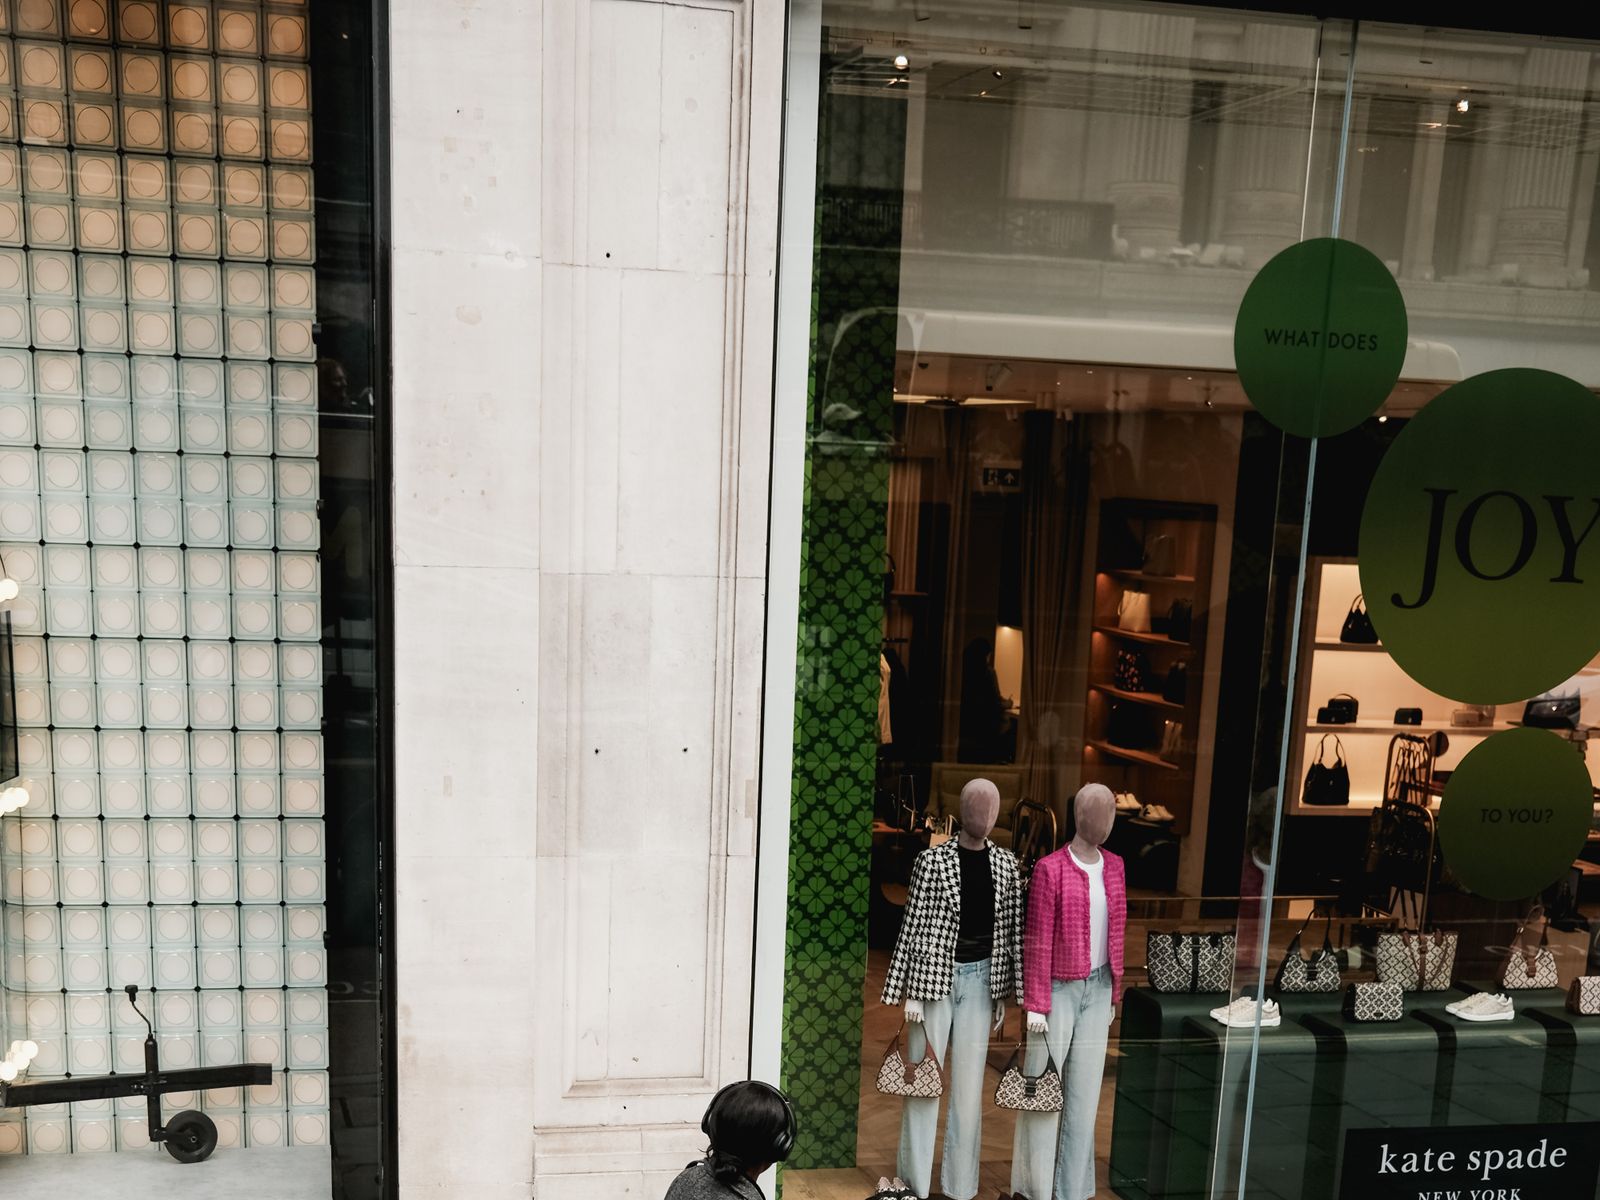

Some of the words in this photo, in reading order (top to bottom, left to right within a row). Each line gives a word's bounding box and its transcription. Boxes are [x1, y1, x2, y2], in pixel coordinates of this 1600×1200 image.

[1264, 328, 1320, 347] WHAT
[1328, 332, 1378, 351] DOES
[1391, 487, 1600, 609] JOY
[1481, 808, 1502, 823] TO
[1508, 808, 1554, 824] YOU?
[1378, 1144, 1456, 1174] kate
[1467, 1138, 1568, 1181] spade
